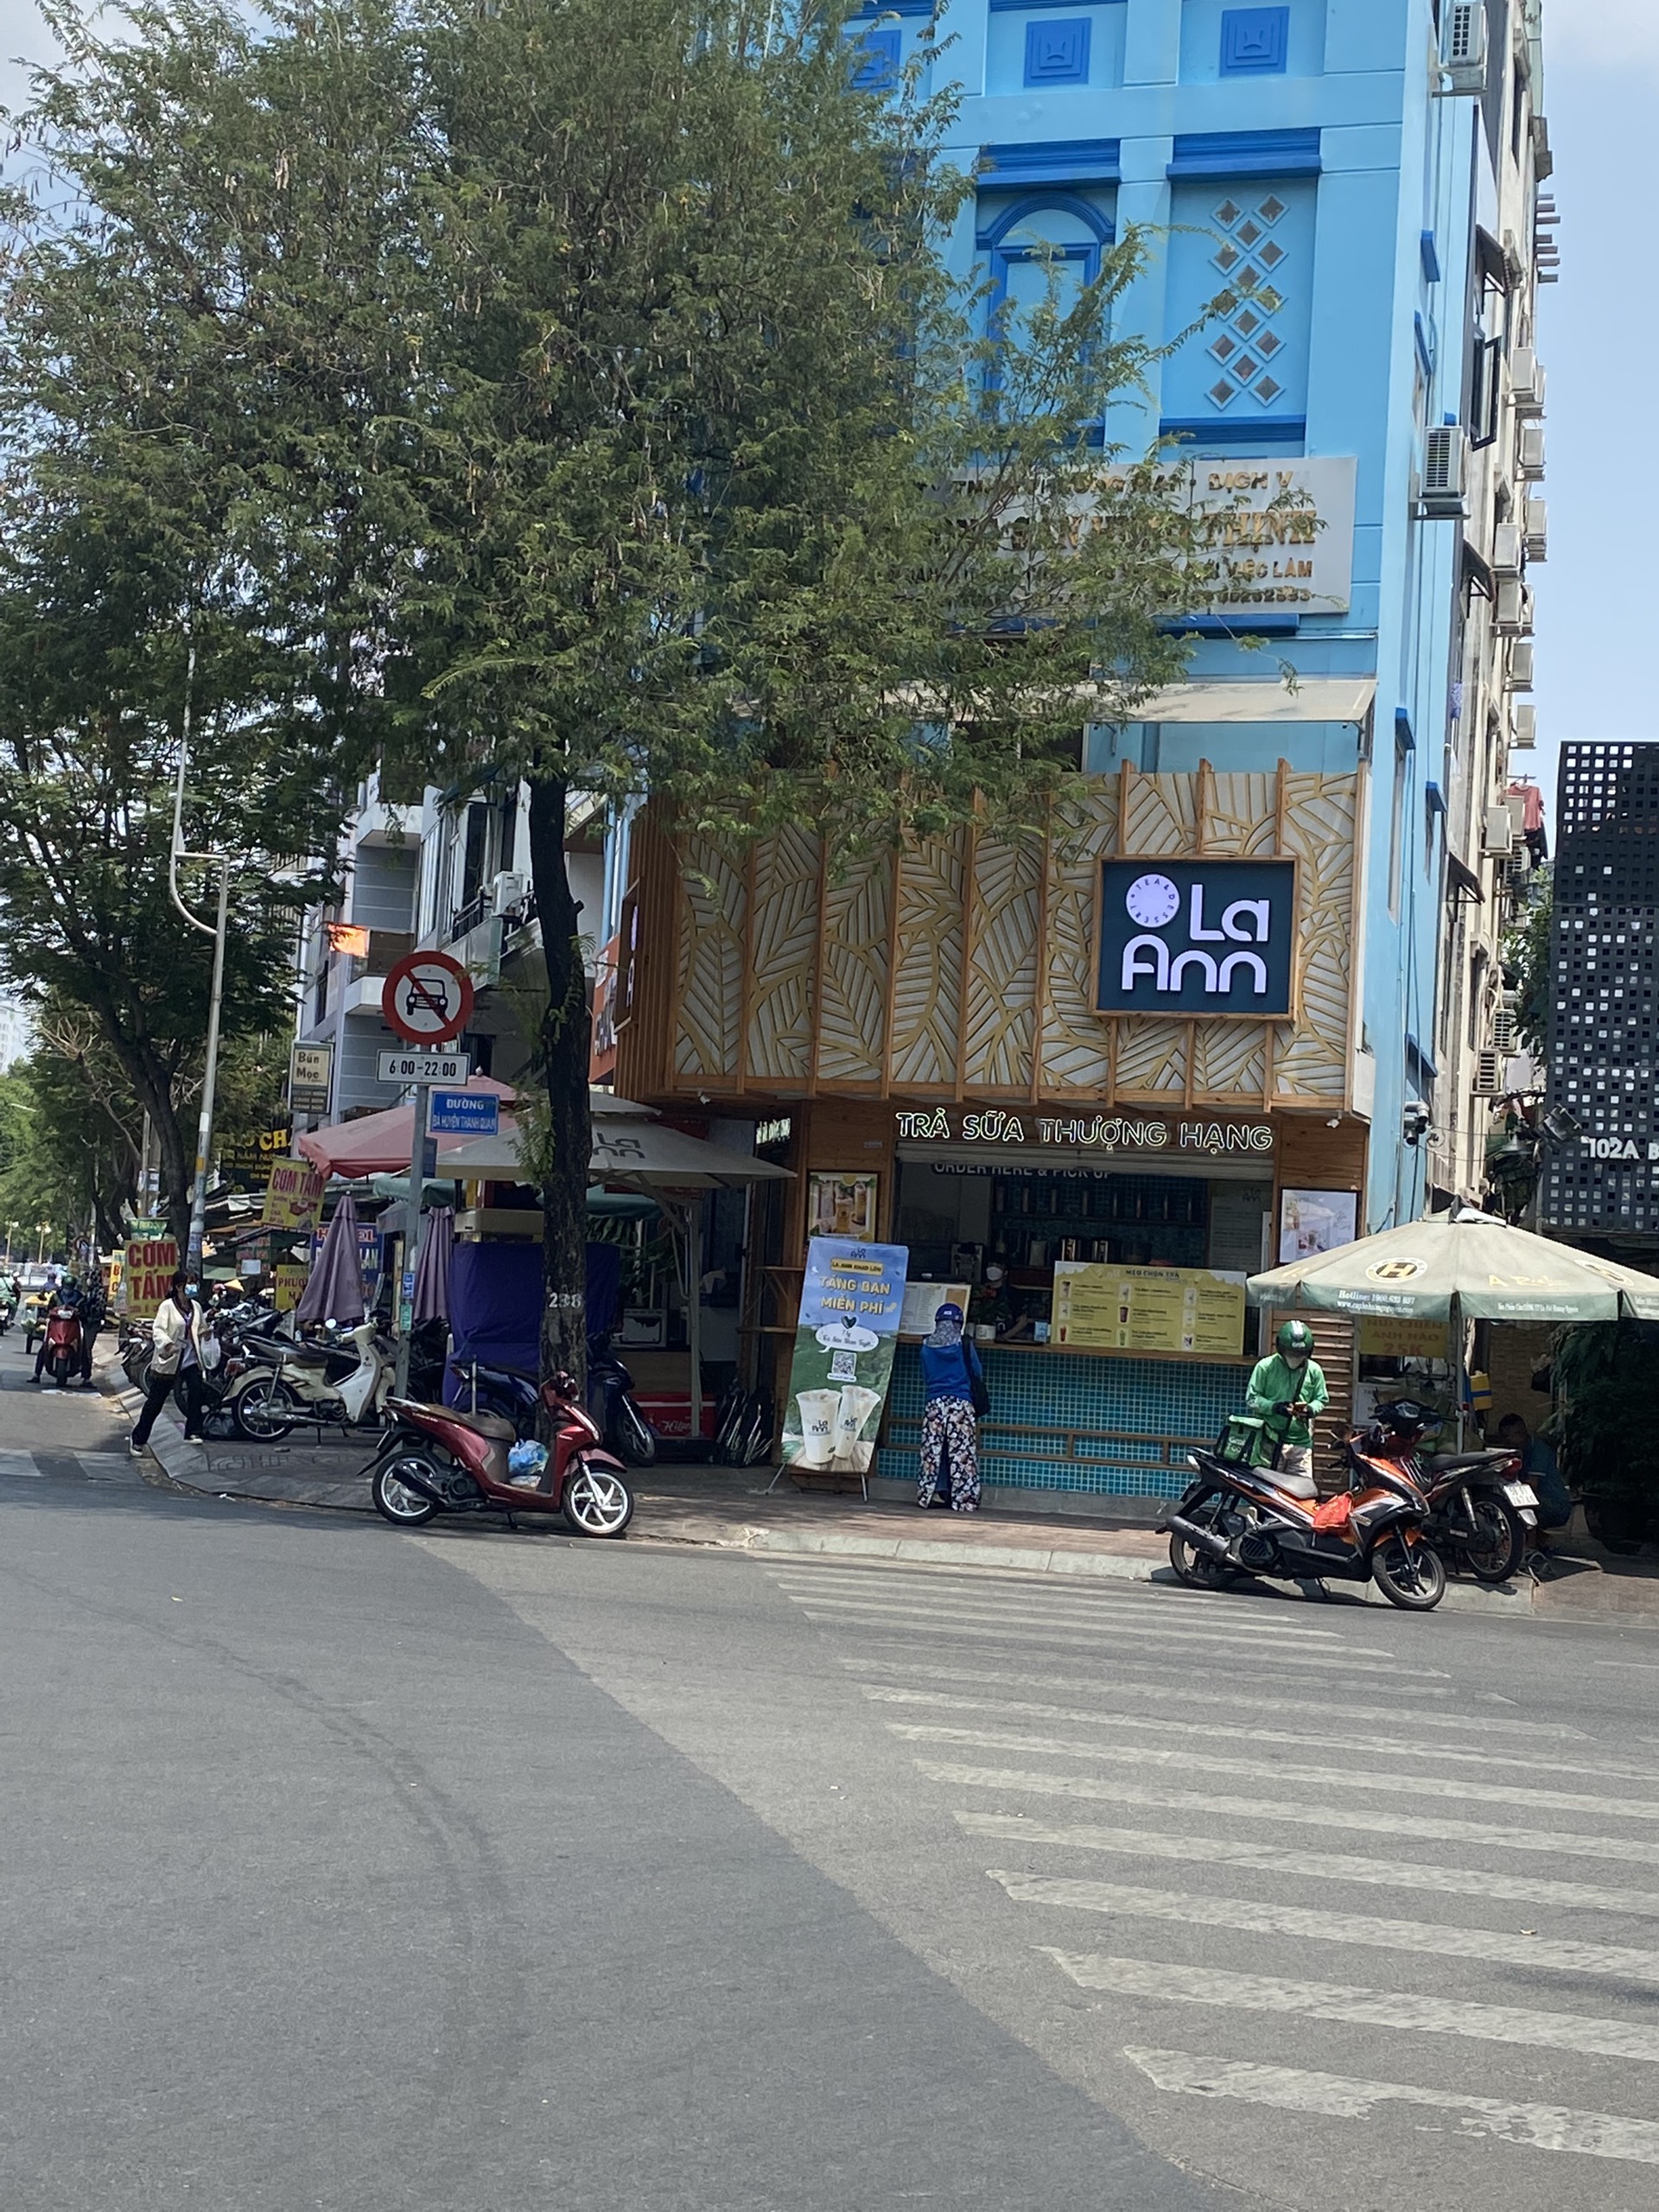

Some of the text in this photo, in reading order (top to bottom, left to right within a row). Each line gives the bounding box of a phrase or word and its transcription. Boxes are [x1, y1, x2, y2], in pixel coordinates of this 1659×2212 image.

[1208, 471, 1268, 493] DỊCH
[1273, 557, 1313, 578] LÀM
[1190, 884, 1270, 942] La
[1122, 934, 1267, 994] Ann
[297, 1052, 320, 1065] Bún
[389, 1060, 456, 1077] 6:00-22:00
[296, 1066, 320, 1080] Mọc
[446, 1097, 485, 1110] ĐƯỜNG
[259, 1129, 292, 1151] CH
[596, 1132, 641, 1149] La
[895, 1107, 1274, 1155] TRÀ SỮA THƯỢNG HẠNG
[592, 1146, 646, 1159] nn
[1587, 1136, 1640, 1160] 102A
[130, 1241, 177, 1268] CƠM
[1380, 1262, 1418, 1278] H
[130, 1268, 174, 1300] TẤM
[861, 1281, 891, 1298] BẠN
[820, 1294, 884, 1314] MIỄN PHÍ
